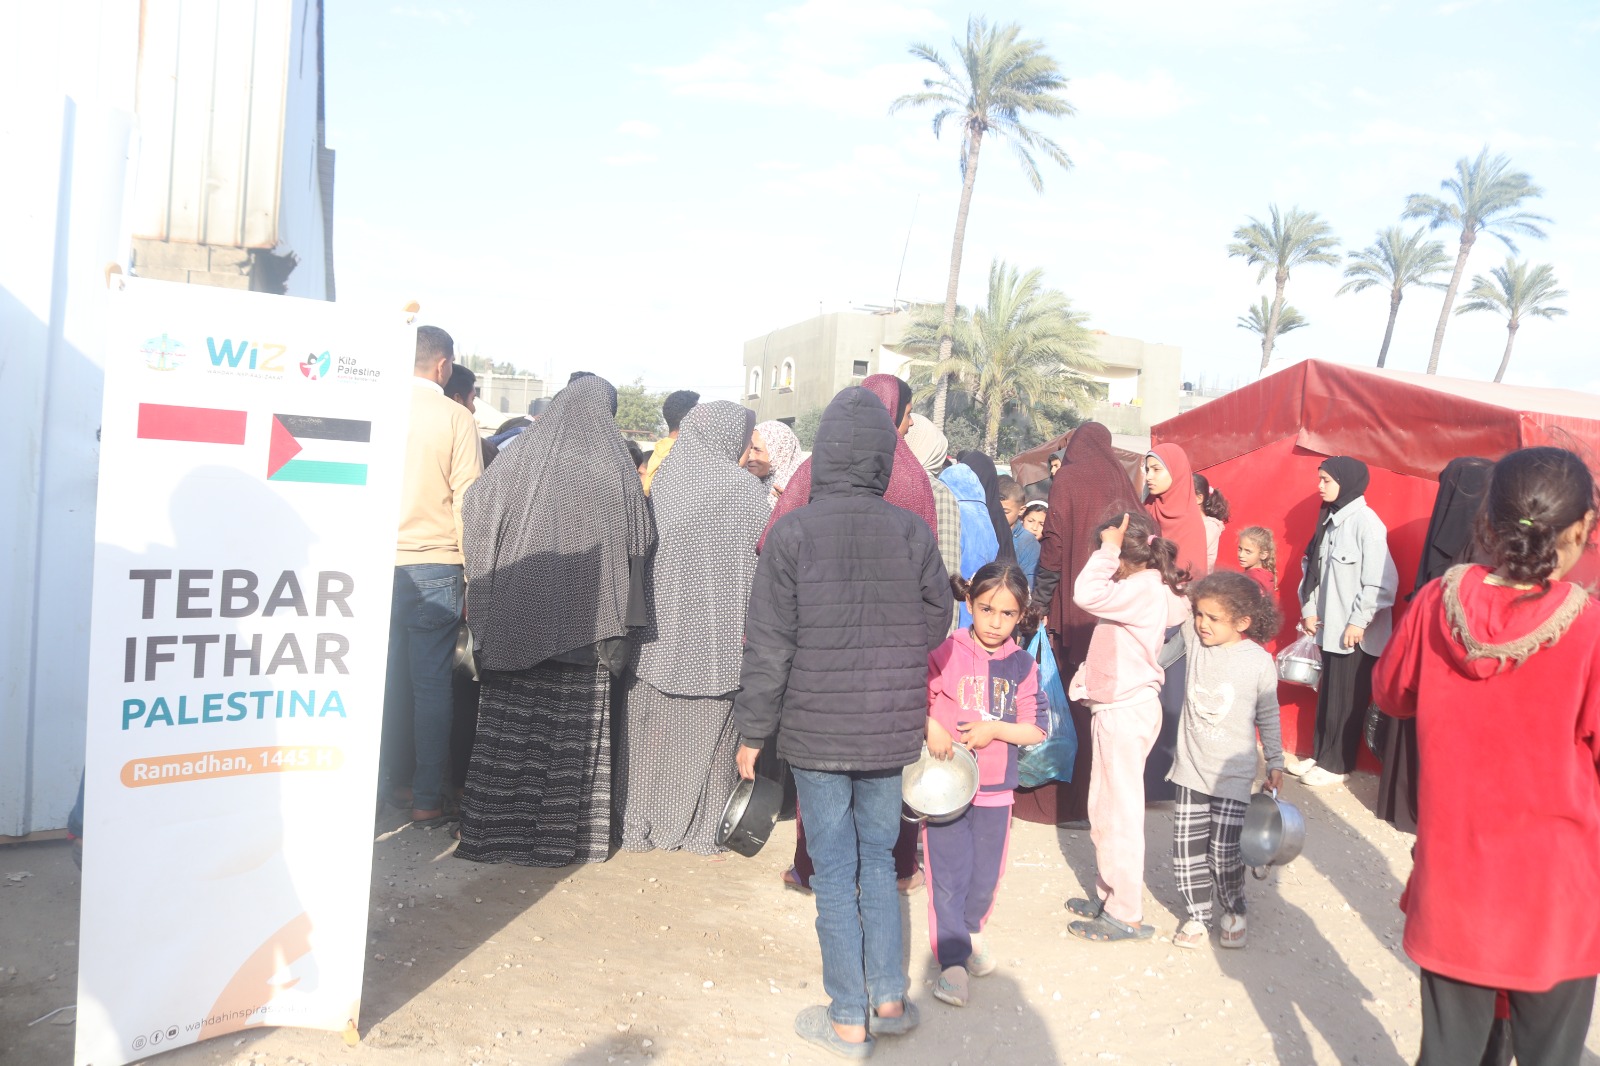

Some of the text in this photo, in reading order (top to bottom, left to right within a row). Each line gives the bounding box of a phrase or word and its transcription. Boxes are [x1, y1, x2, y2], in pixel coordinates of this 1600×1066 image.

[206, 336, 287, 373] WiZ
[337, 365, 381, 378] Palestina
[338, 355, 357, 366] Kita
[129, 569, 355, 619] TEBAR
[124, 633, 350, 683] IFTHAR
[121, 690, 347, 730] PALESTINA
[133, 750, 333, 781] Ramadhan, 1445 H
